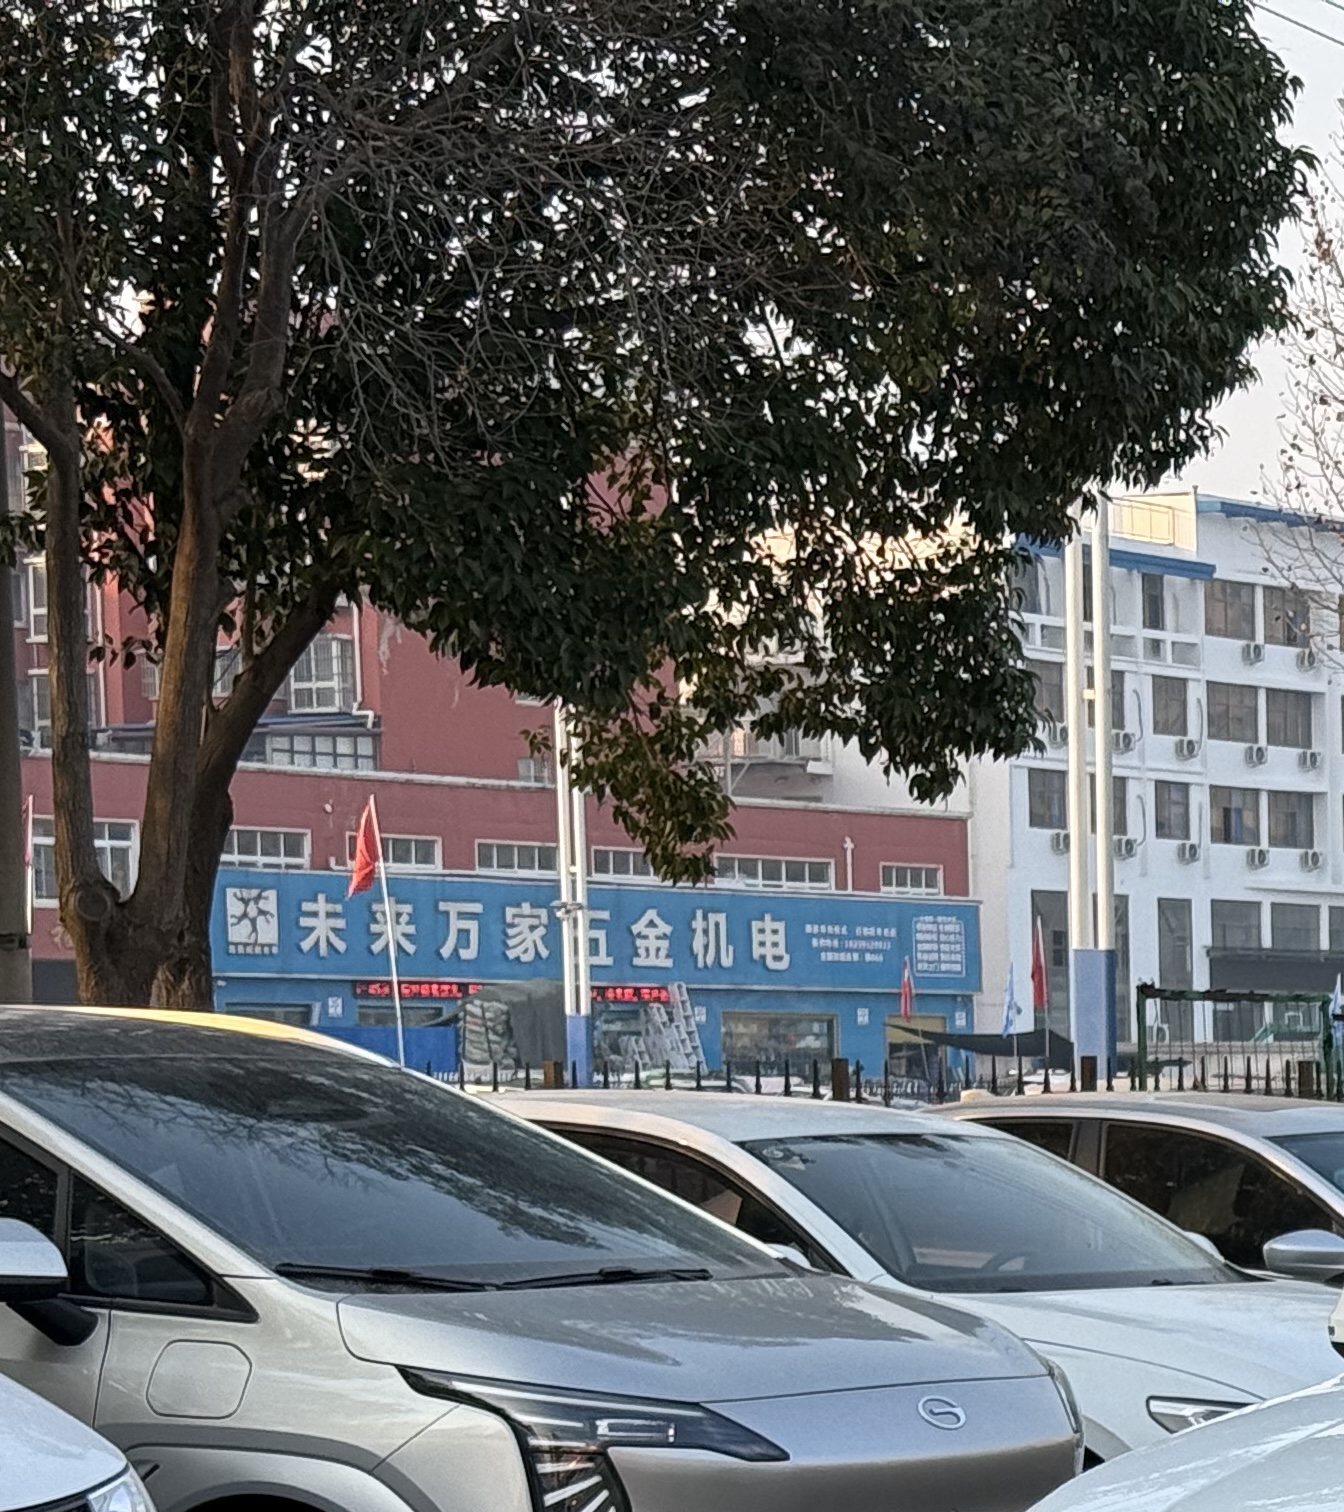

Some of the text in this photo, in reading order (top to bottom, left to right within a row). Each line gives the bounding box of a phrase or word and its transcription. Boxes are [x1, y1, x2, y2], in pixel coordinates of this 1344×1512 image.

[298, 892, 792, 972] 未来万家五金机电
